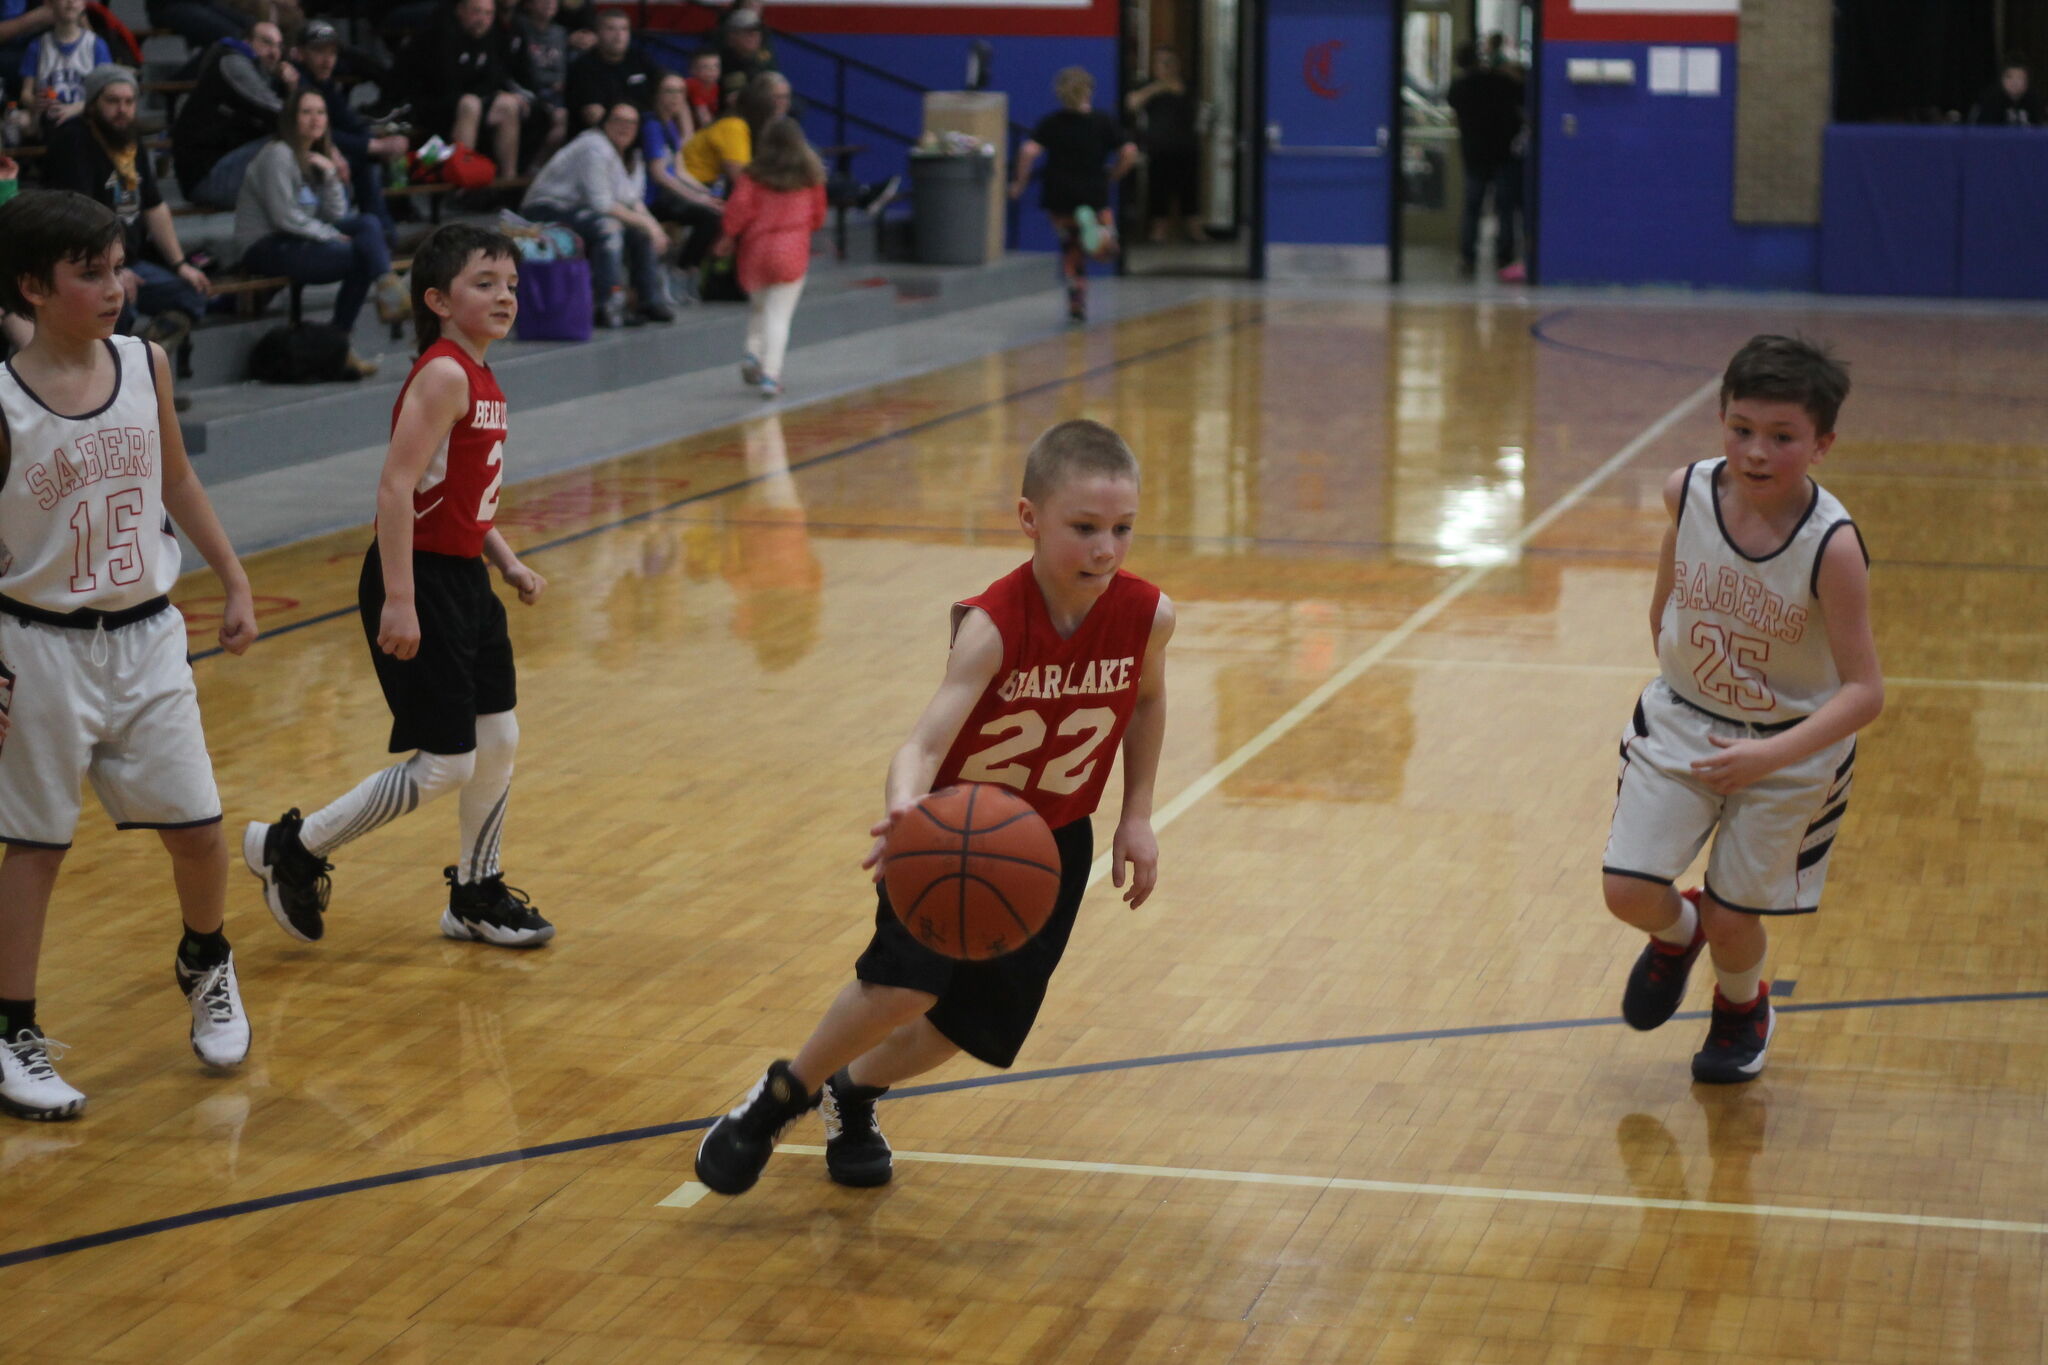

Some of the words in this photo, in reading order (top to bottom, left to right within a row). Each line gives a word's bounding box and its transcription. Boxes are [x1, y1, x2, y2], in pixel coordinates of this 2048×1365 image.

[25, 427, 154, 511] SABER
[70, 487, 145, 593] 15
[1674, 561, 1809, 645] SABERS
[1691, 620, 1776, 711] 25
[957, 706, 1117, 796] 22
